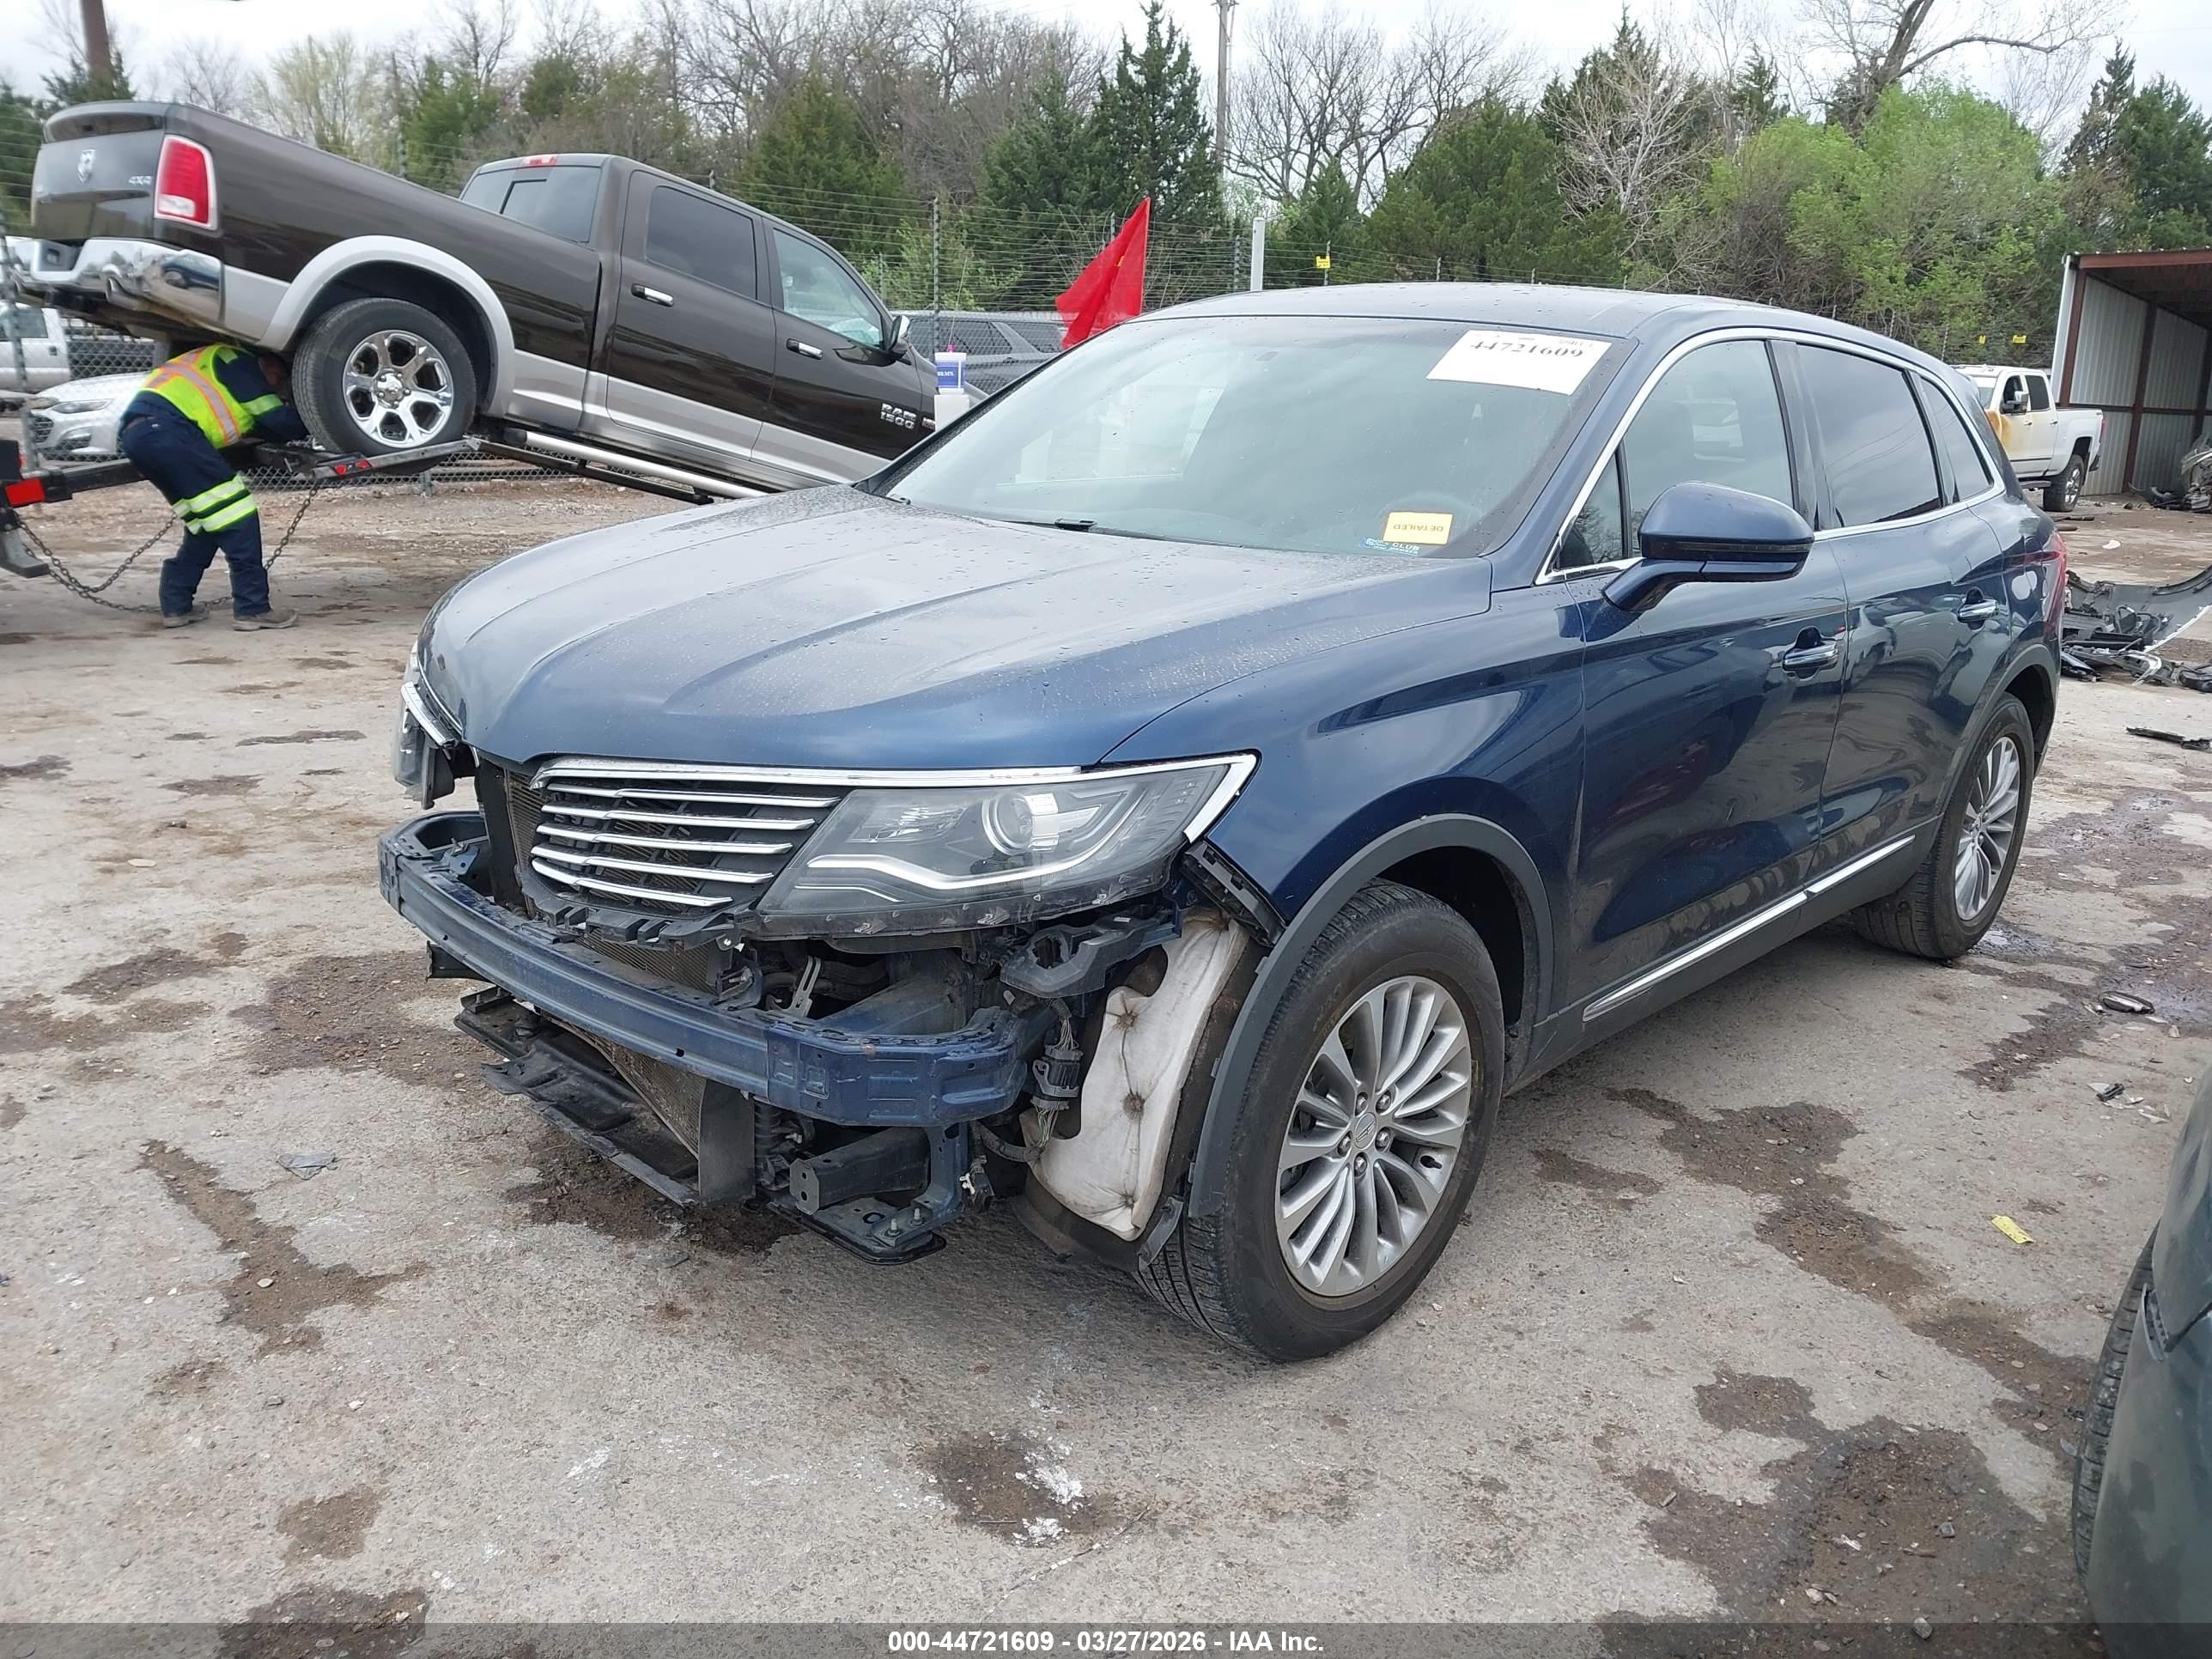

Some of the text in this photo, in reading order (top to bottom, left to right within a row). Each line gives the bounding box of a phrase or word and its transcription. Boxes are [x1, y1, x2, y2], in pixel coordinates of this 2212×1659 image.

[1470, 340, 1584, 358] 44721609
[879, 411, 915, 430] 1500
[881, 403, 917, 422] RAM
[1393, 523, 1444, 532] DETAILED
